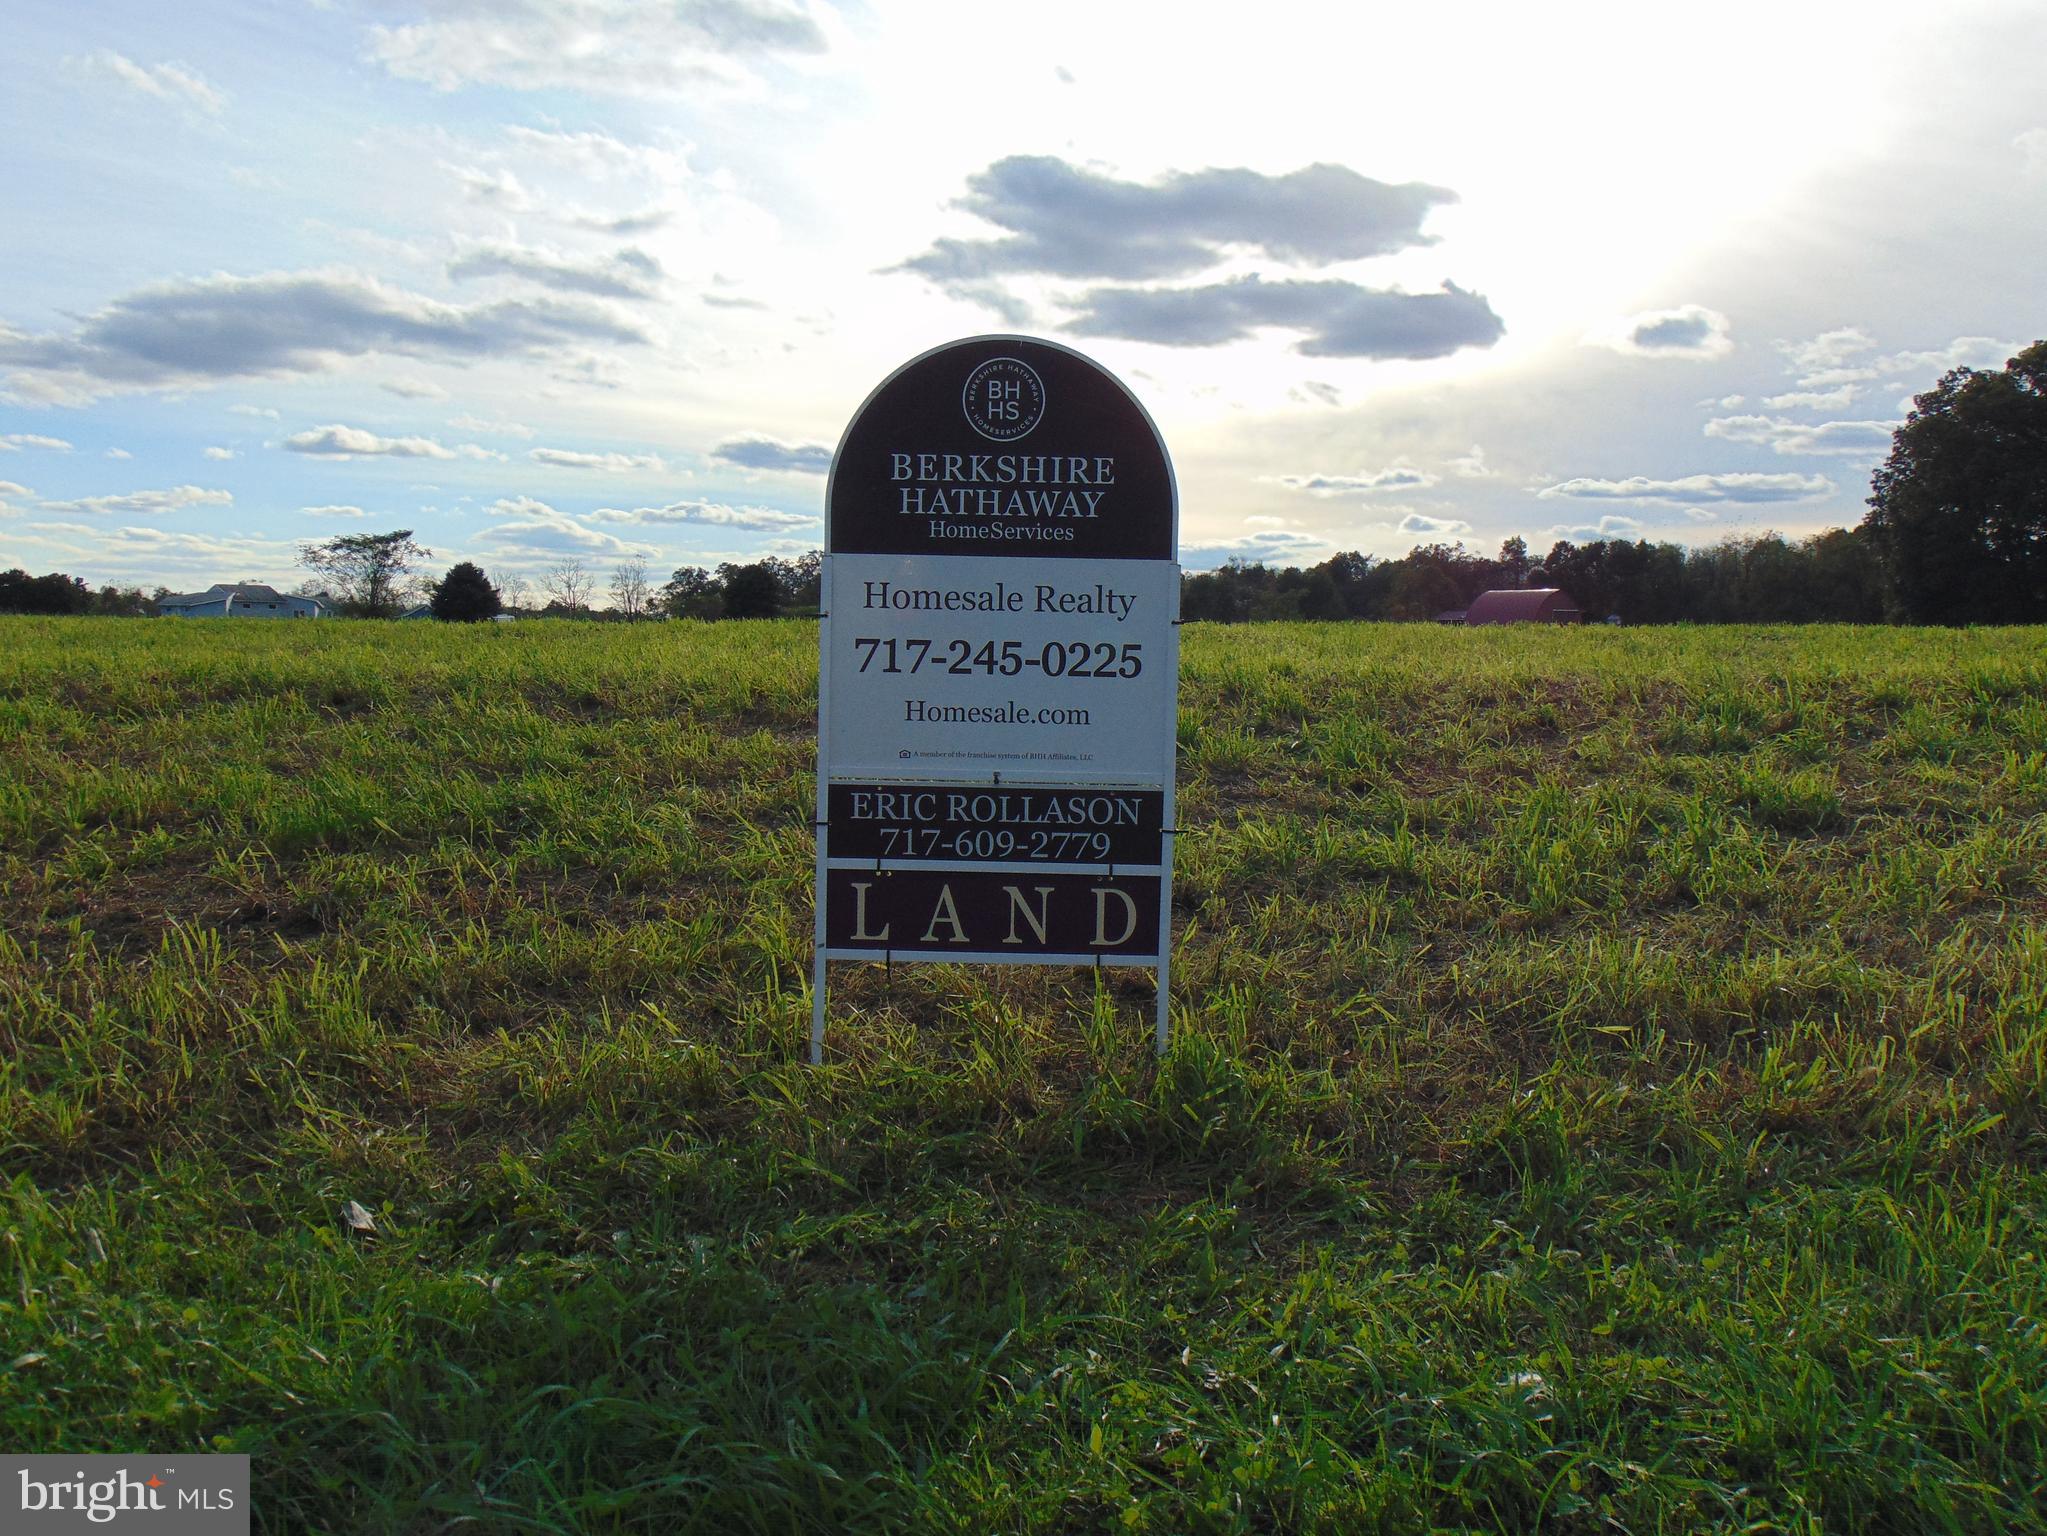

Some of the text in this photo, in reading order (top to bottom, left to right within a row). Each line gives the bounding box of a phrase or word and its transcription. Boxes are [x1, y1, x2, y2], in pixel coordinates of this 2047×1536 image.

[969, 363, 1040, 402] BERKSHIRE HATHAWAY
[988, 380, 1020, 399] BH
[973, 413, 1034, 435] HOMESERVICES
[988, 401, 1020, 420] HS
[891, 453, 1115, 485] BERKSHIRE
[899, 487, 1106, 518] HATHAWAY
[929, 520, 1075, 542] HomeServices
[863, 581, 1138, 622] Homesale Realty
[854, 638, 1143, 679] 717-245-0225
[904, 700, 1091, 726] Homesale.com
[920, 750, 947, 758] member
[948, 750, 955, 758] of
[955, 750, 966, 758] the
[967, 751, 997, 759] franchise
[998, 752, 1021, 761] system
[1021, 752, 1029, 760] of
[850, 792, 1143, 825] ERIC ROLLASON
[880, 828, 1112, 859] 717-609-2779
[850, 882, 1138, 946] LAND
